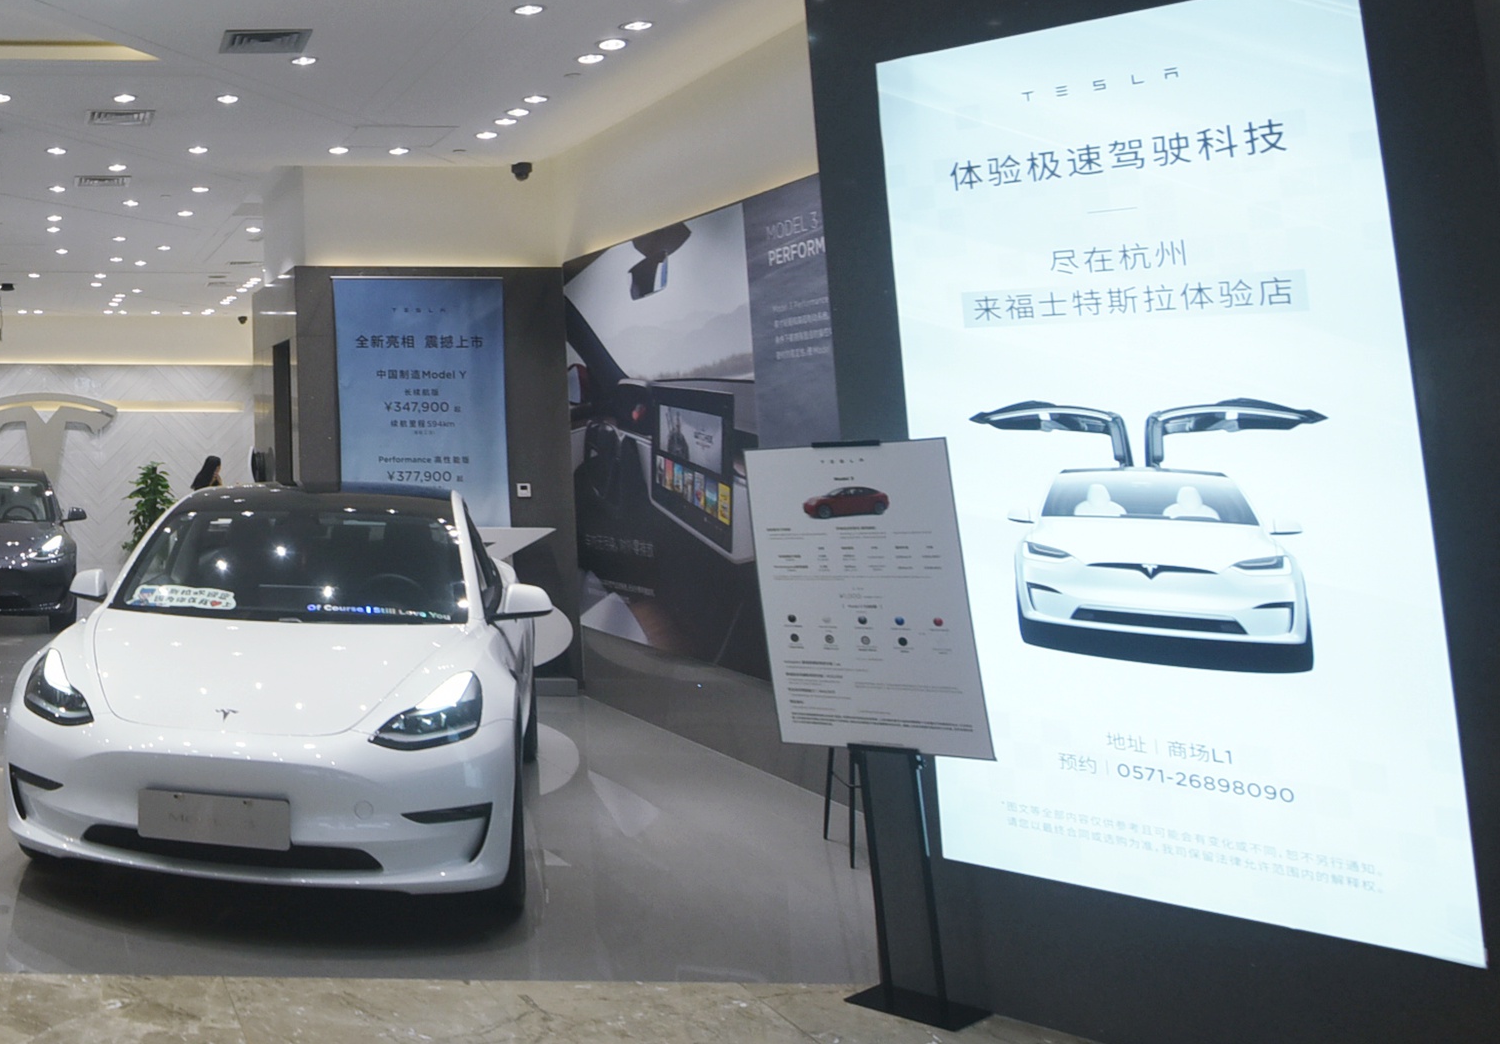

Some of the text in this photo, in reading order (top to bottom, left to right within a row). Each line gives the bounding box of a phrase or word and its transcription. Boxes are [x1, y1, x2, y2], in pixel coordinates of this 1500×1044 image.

[1021, 66, 1180, 103] TESLA
[949, 118, 1288, 193] 体验极速驾驶科技
[766, 211, 819, 240] MODEL 3
[1049, 239, 1188, 276] 尽在杭州
[973, 276, 1294, 323] 来福士特斯拉体验店
[355, 335, 484, 349] 全新亮相 震撼上市
[376, 369, 467, 380] 中国制造Model Y
[384, 402, 450, 413] ¥347,900
[378, 456, 470, 464] Performance 高性能版
[387, 471, 452, 483] ¥377,900
[307, 604, 321, 612] Of
[323, 604, 364, 613] Course
[373, 606, 396, 615] Still
[398, 609, 427, 618] Love
[428, 611, 451, 621] You
[1105, 731, 1234, 766] 地址 商场L1
[1058, 752, 1295, 804] 预约 0571-26898090
